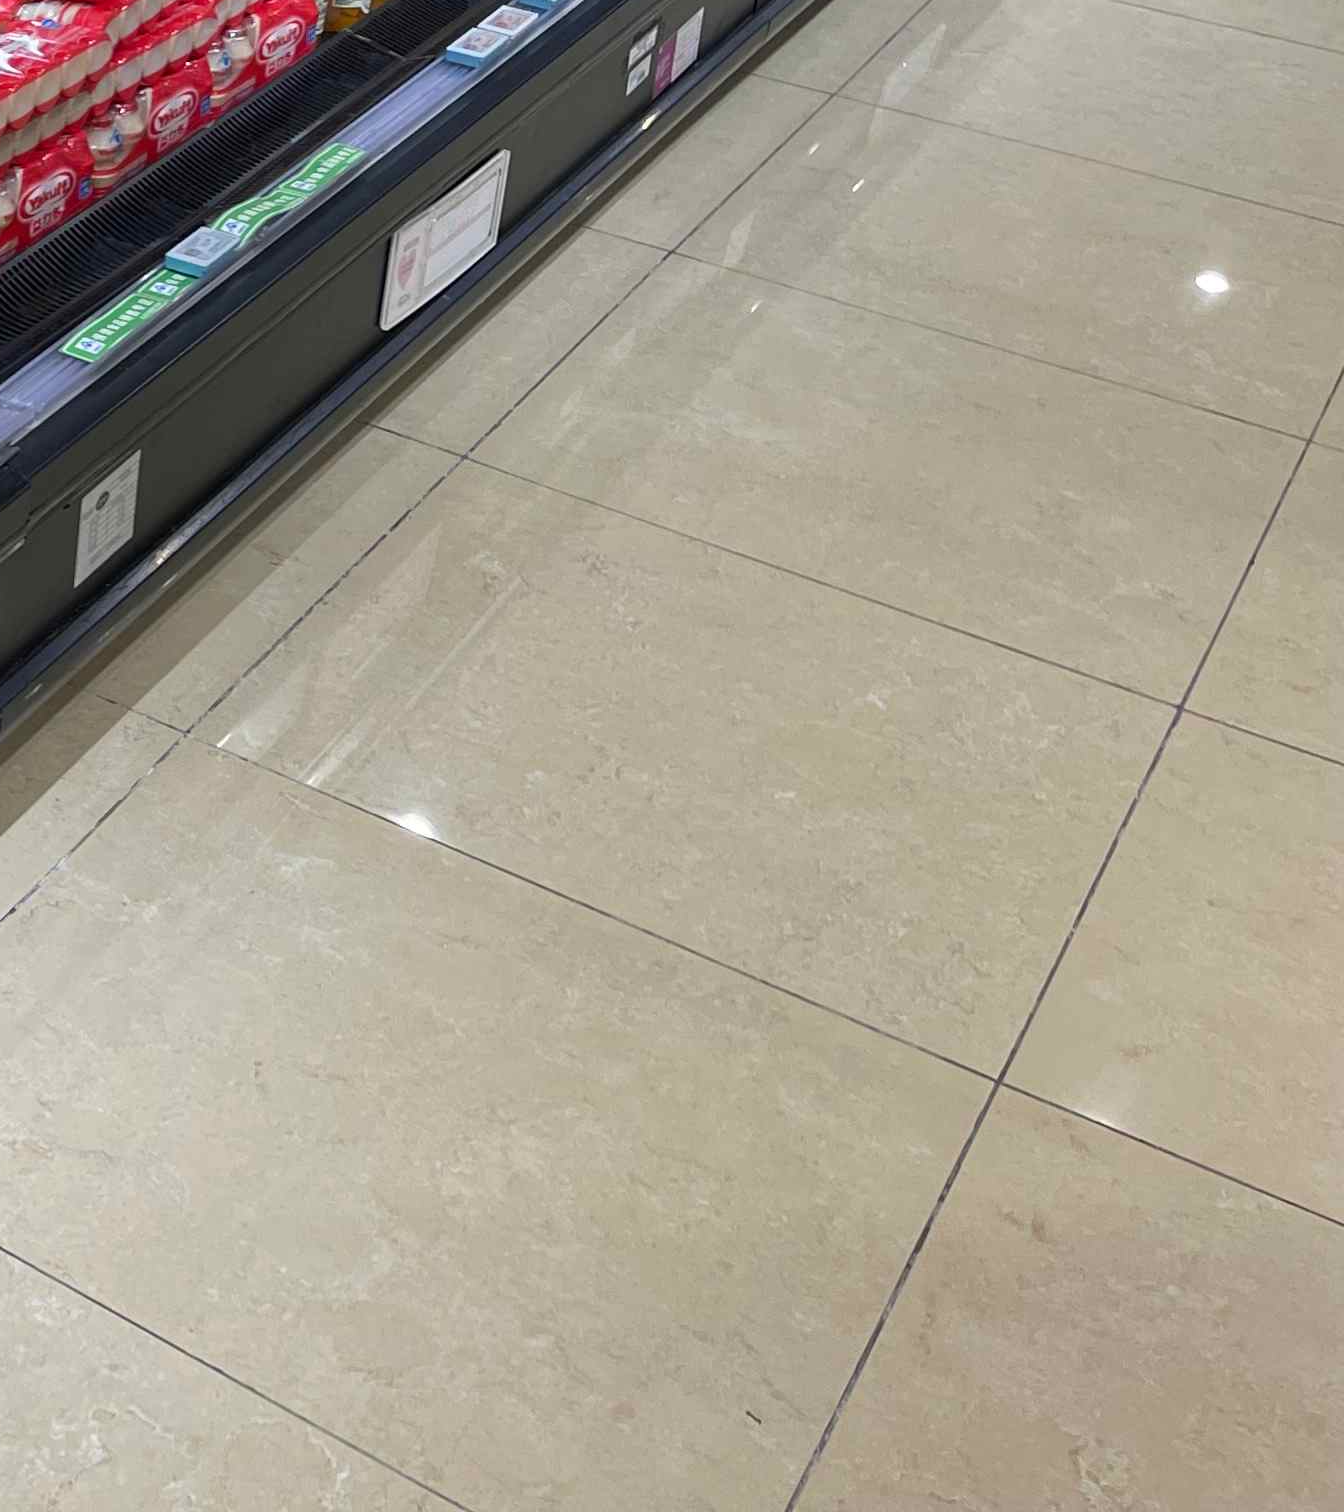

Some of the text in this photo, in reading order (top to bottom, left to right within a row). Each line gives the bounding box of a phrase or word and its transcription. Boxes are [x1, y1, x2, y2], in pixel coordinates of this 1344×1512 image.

[262, 28, 305, 55] Yakult
[153, 101, 195, 127] Yakult
[23, 179, 71, 210] Yakult
